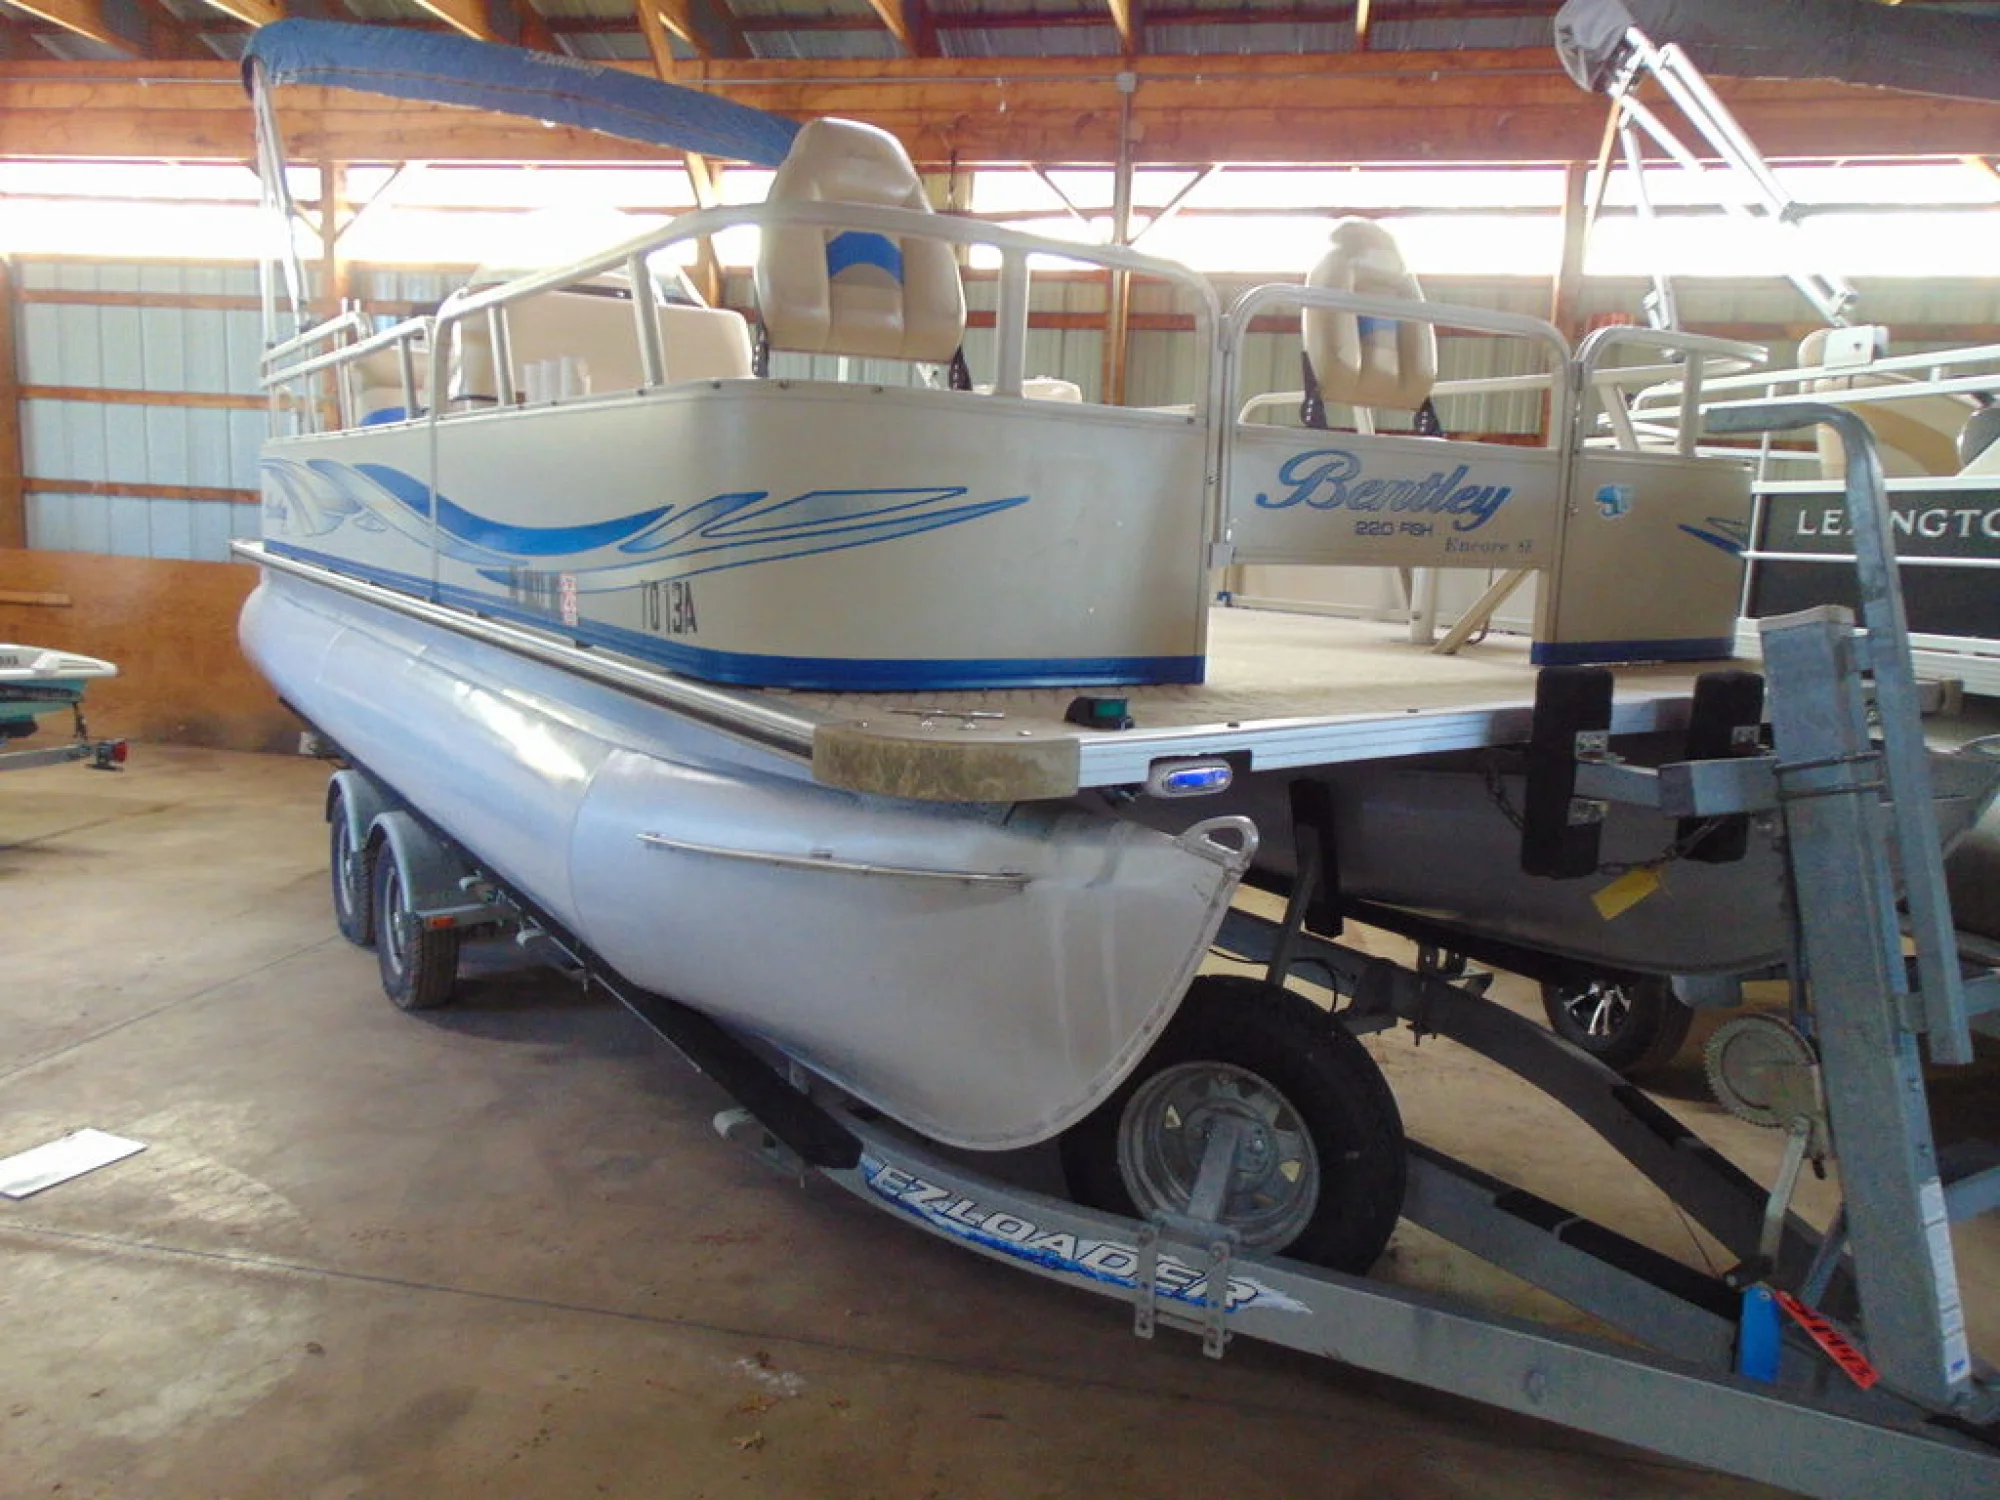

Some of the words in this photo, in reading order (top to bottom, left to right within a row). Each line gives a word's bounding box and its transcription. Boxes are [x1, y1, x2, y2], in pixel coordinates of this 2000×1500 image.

[1255, 449, 1512, 532] Bentley
[1355, 520, 1394, 536] 220
[1796, 509, 2000, 538] LENGTO
